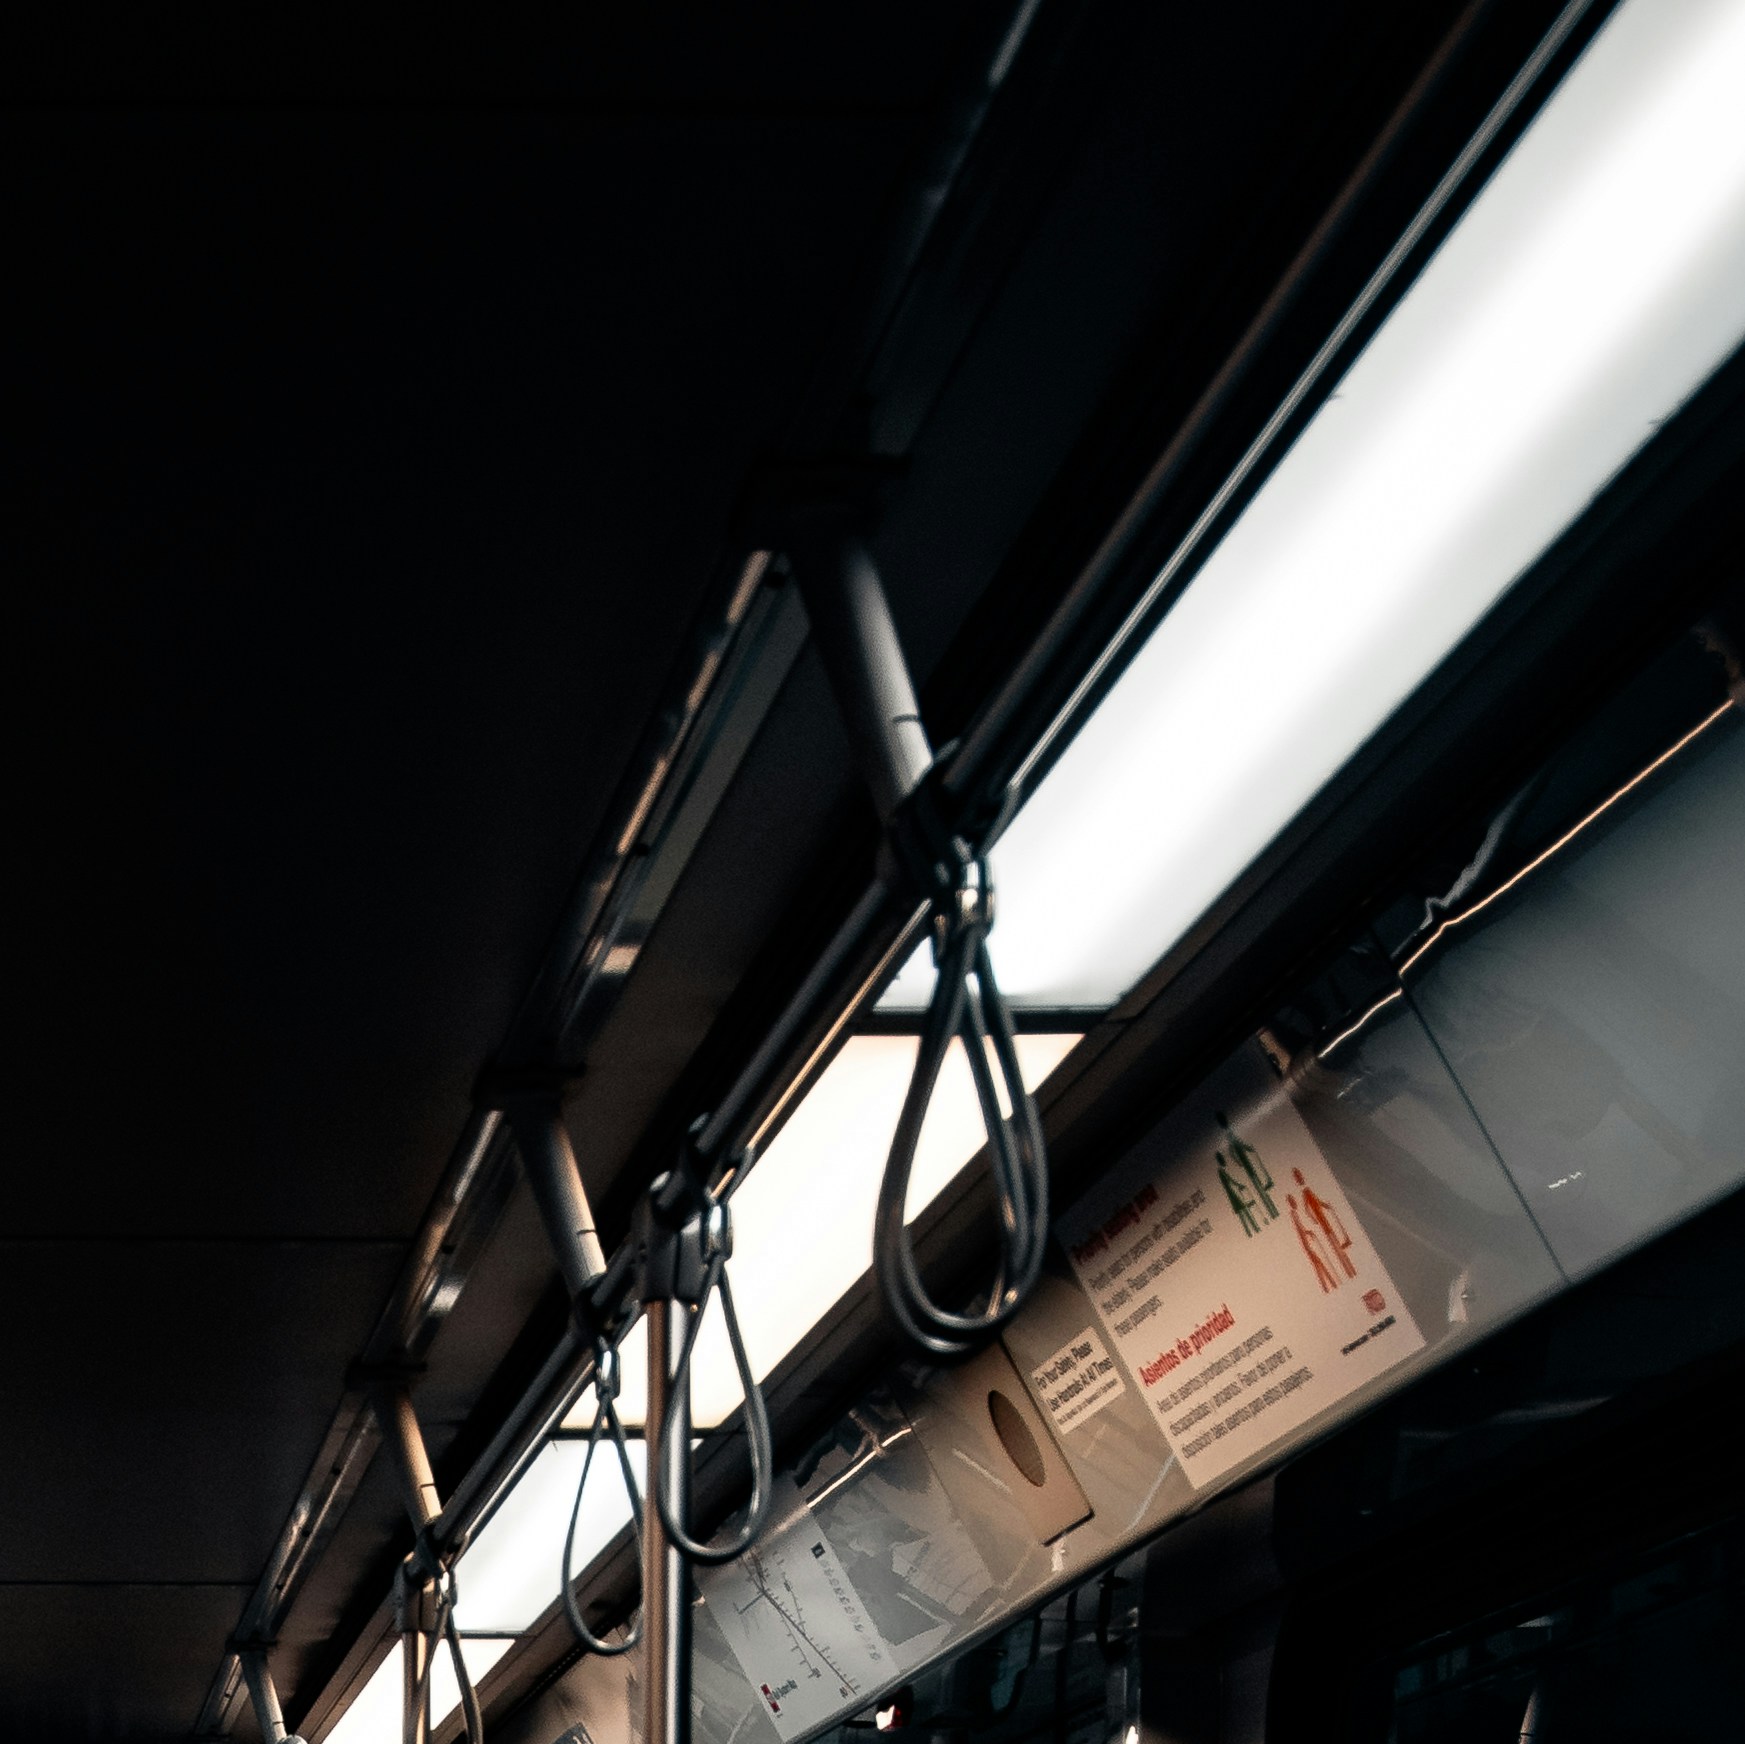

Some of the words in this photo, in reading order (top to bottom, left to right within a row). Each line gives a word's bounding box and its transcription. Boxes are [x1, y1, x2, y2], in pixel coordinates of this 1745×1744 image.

[1139, 1350, 1180, 1386] Asientos
[1177, 1339, 1193, 1359] de
[1189, 1304, 1234, 1354] prioridad
